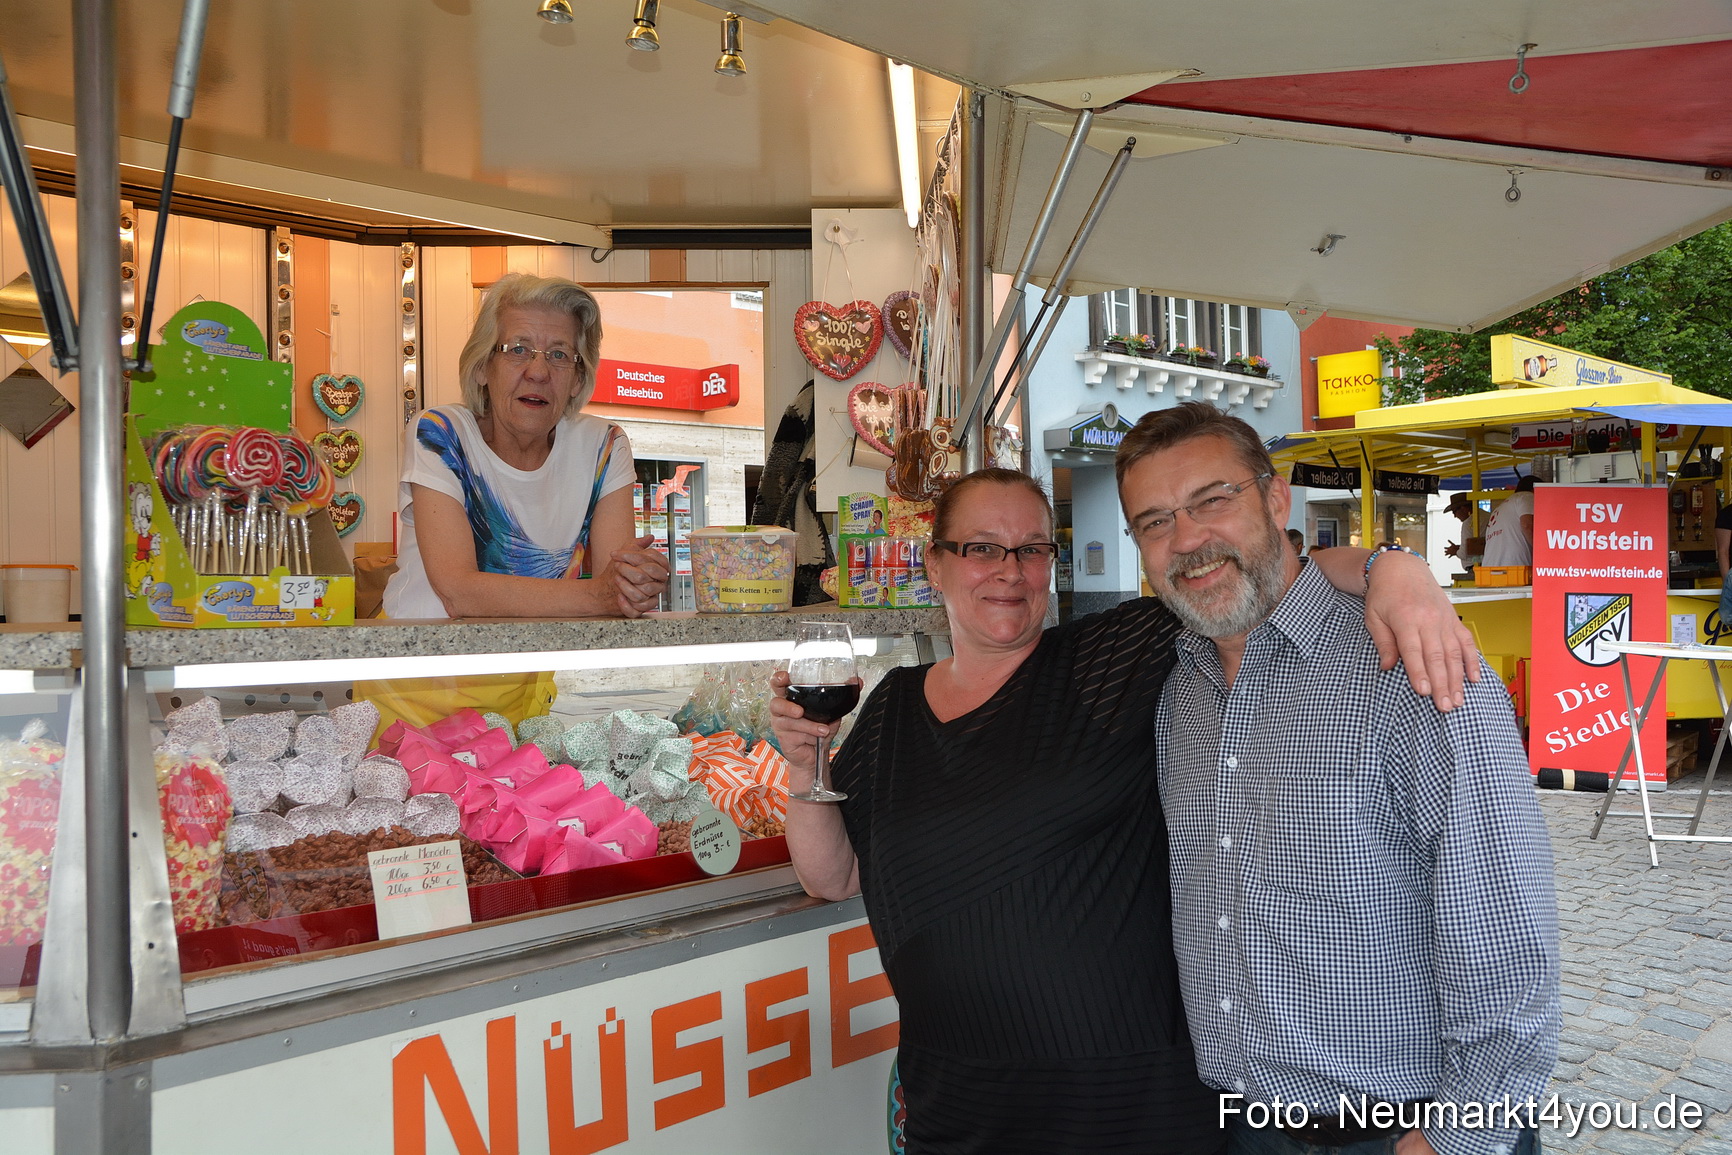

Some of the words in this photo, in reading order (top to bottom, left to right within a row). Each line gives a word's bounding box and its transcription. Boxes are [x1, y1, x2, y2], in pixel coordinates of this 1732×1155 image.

[824, 318, 855, 337] 100%
[816, 331, 865, 352] Single
[616, 368, 665, 384] Deutsches
[617, 385, 664, 400] Reisebüro
[702, 375, 727, 397] DER
[1330, 388, 1367, 396] FASHION
[1537, 428, 1564, 443] Die
[850, 499, 874, 512] SCHAUM
[1576, 503, 1623, 523] TSV
[853, 510, 871, 521] SPRAY
[1546, 529, 1653, 551] Wolfstein
[1536, 565, 1663, 579] www.tsv-wolfstein.de
[206, 587, 252, 606] Charly's
[739, 586, 761, 594] Ketten
[1568, 611, 1609, 647] WOLFSTEIN
[1610, 596, 1628, 615] 1950
[1553, 682, 1611, 714] Die
[691, 817, 721, 839] gebrannte
[693, 831, 724, 850] Erdnüsse
[392, 922, 900, 1155] NÜSSE
